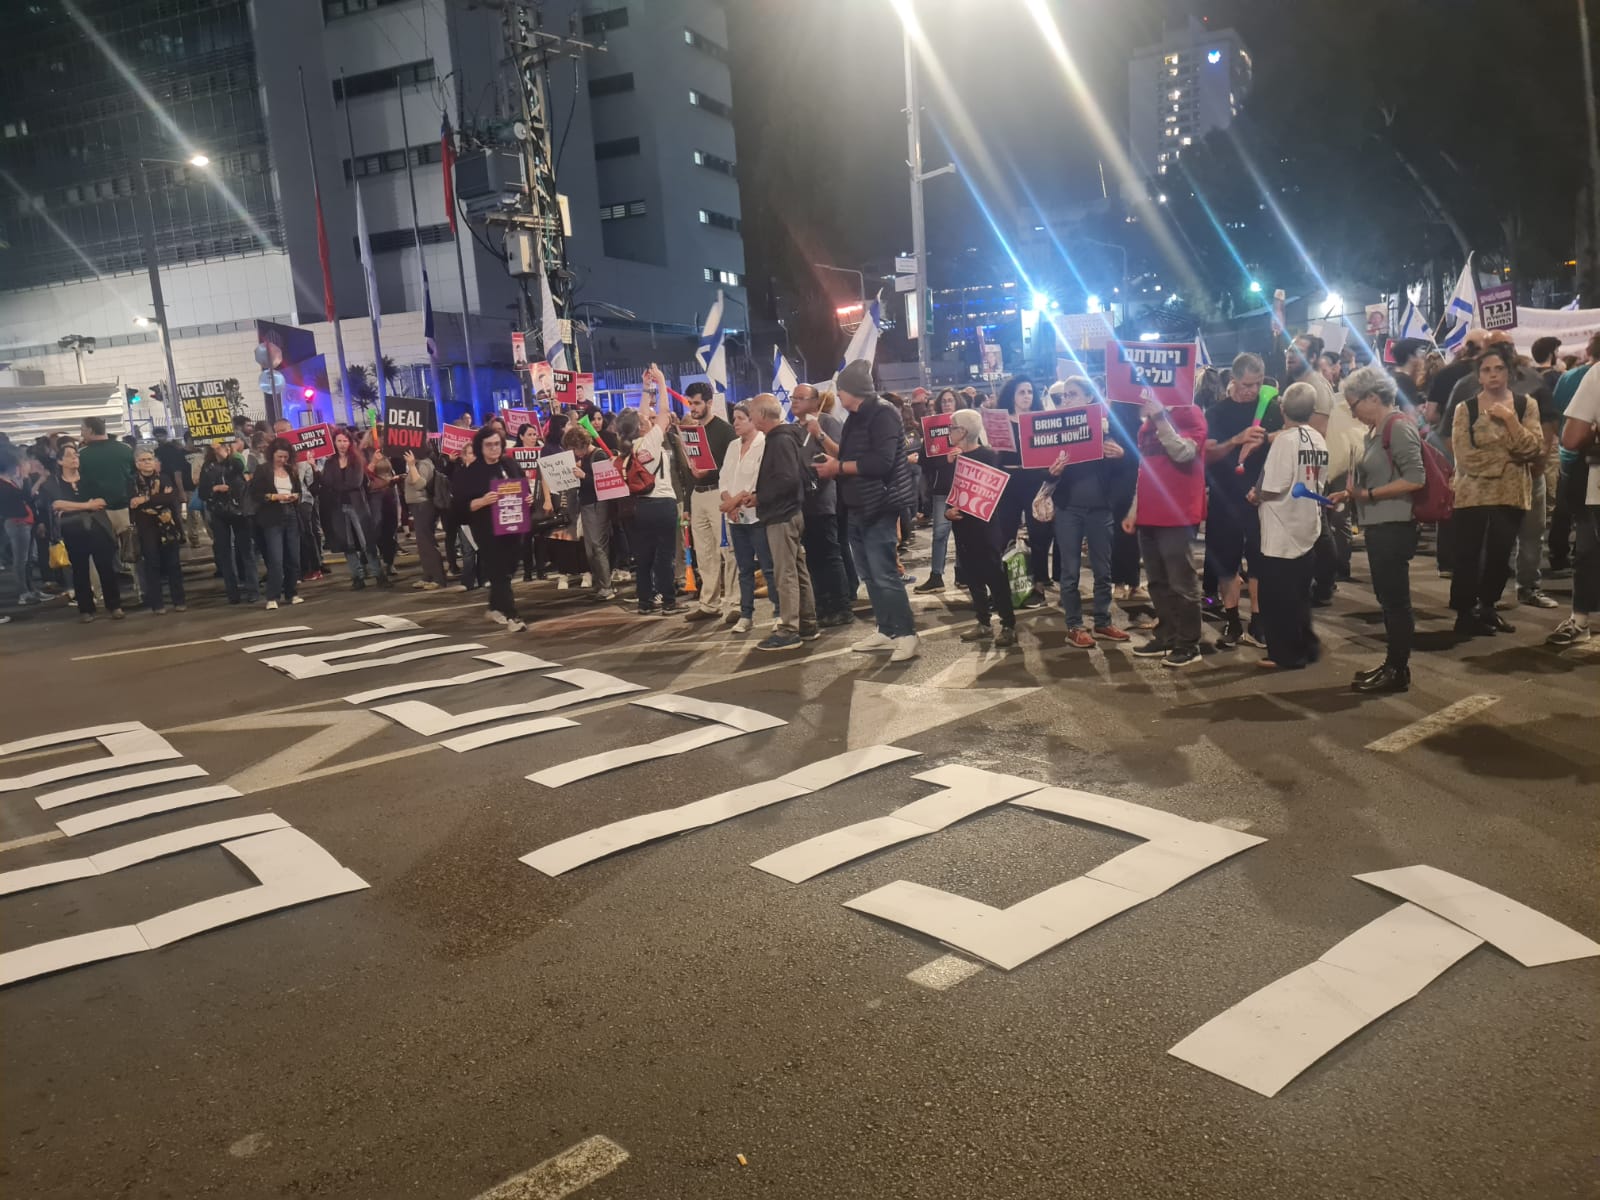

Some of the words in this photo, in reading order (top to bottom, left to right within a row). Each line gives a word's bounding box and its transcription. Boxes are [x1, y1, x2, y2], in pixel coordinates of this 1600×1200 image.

[1485, 302, 1511, 315] נגד
[1136, 366, 1173, 384] עלי?
[180, 383, 200, 398] HEY
[202, 381, 225, 396] JOE!
[183, 399, 202, 412] MR.
[201, 396, 228, 410] BIDEN
[186, 410, 214, 427] HELP
[215, 408, 232, 423] US
[388, 408, 424, 428] DEAL
[1034, 418, 1063, 431] BRING
[1064, 414, 1088, 427] THEM
[190, 425, 212, 437] SAVE
[211, 422, 234, 435] THEM!
[387, 428, 424, 448] NOW
[1033, 433, 1059, 446] HOME
[1061, 426, 1090, 443] NOW!!!
